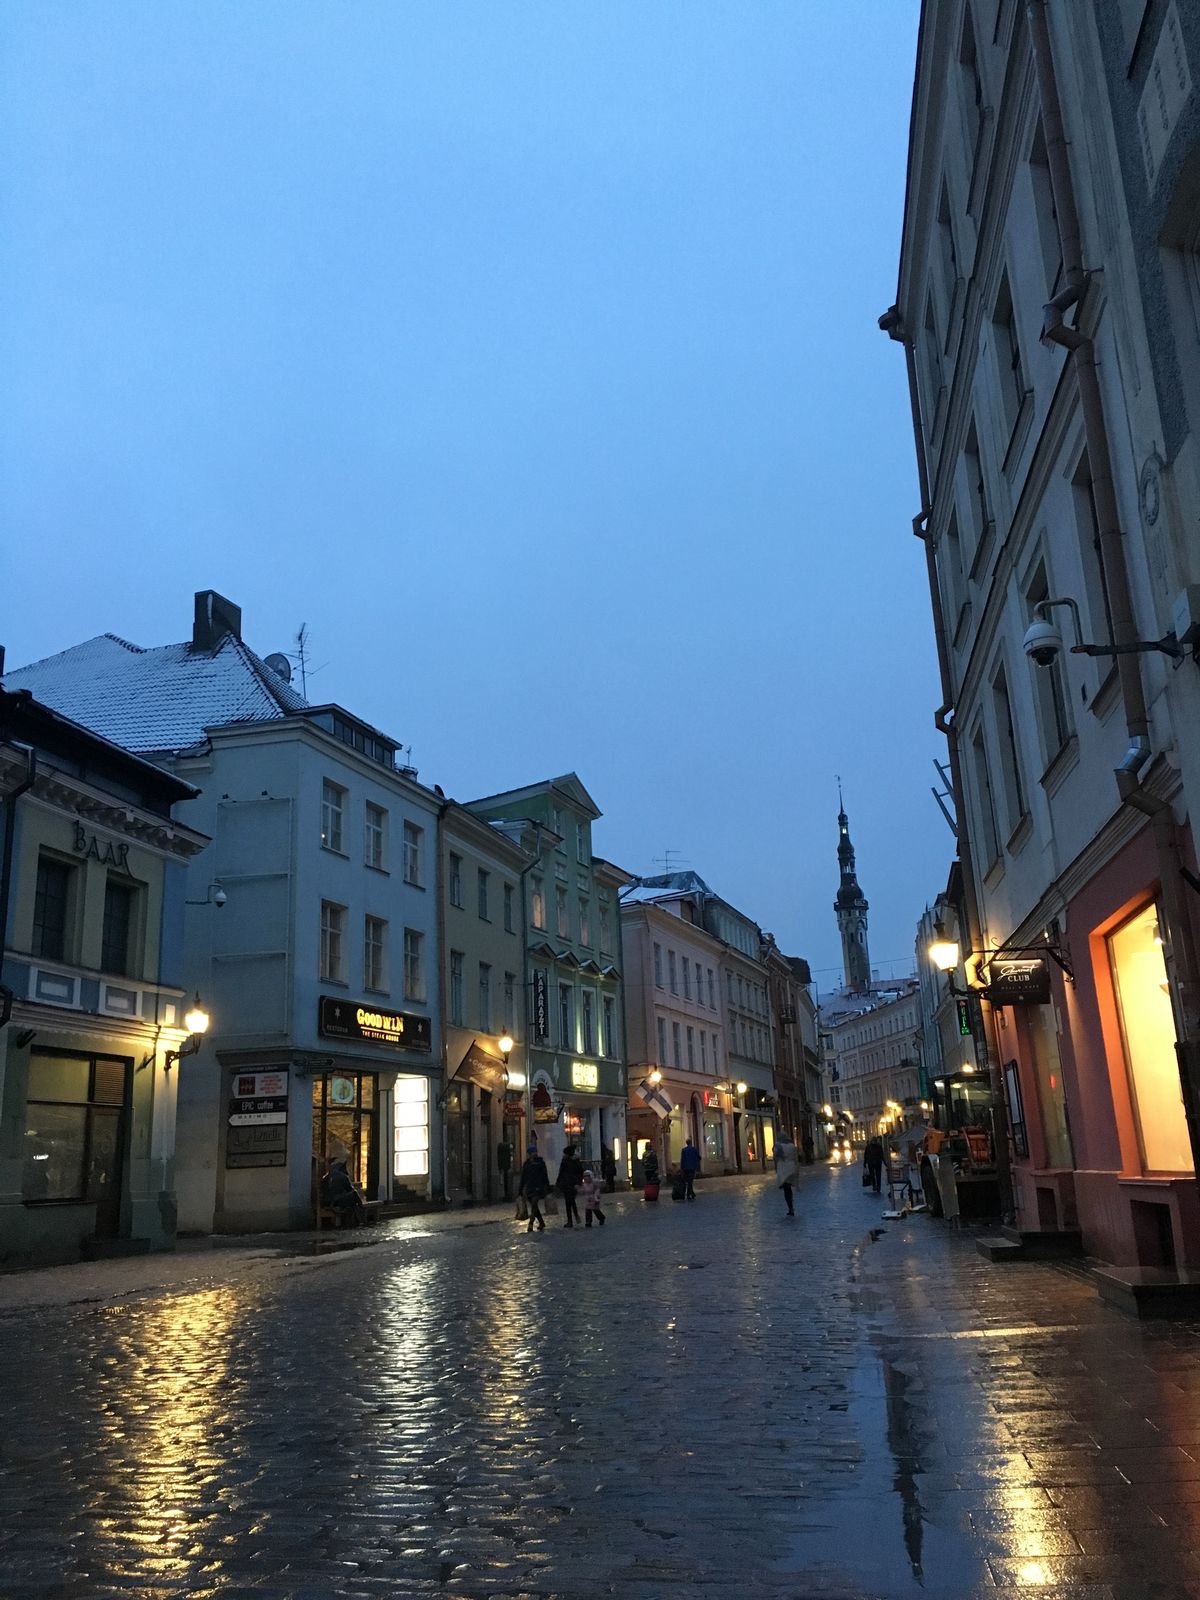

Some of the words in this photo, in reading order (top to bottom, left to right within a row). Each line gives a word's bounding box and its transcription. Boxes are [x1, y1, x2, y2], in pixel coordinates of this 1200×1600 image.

[73, 820, 133, 878] BAAR
[997, 964, 1040, 982] Gourmet
[1007, 974, 1031, 982] CLUB
[537, 971, 545, 1036] PAPARAZZI
[356, 1008, 404, 1033] GOODWIN
[362, 1030, 371, 1038] THE
[241, 1101, 255, 1111] EPIC
[257, 1100, 274, 1110] coffee
